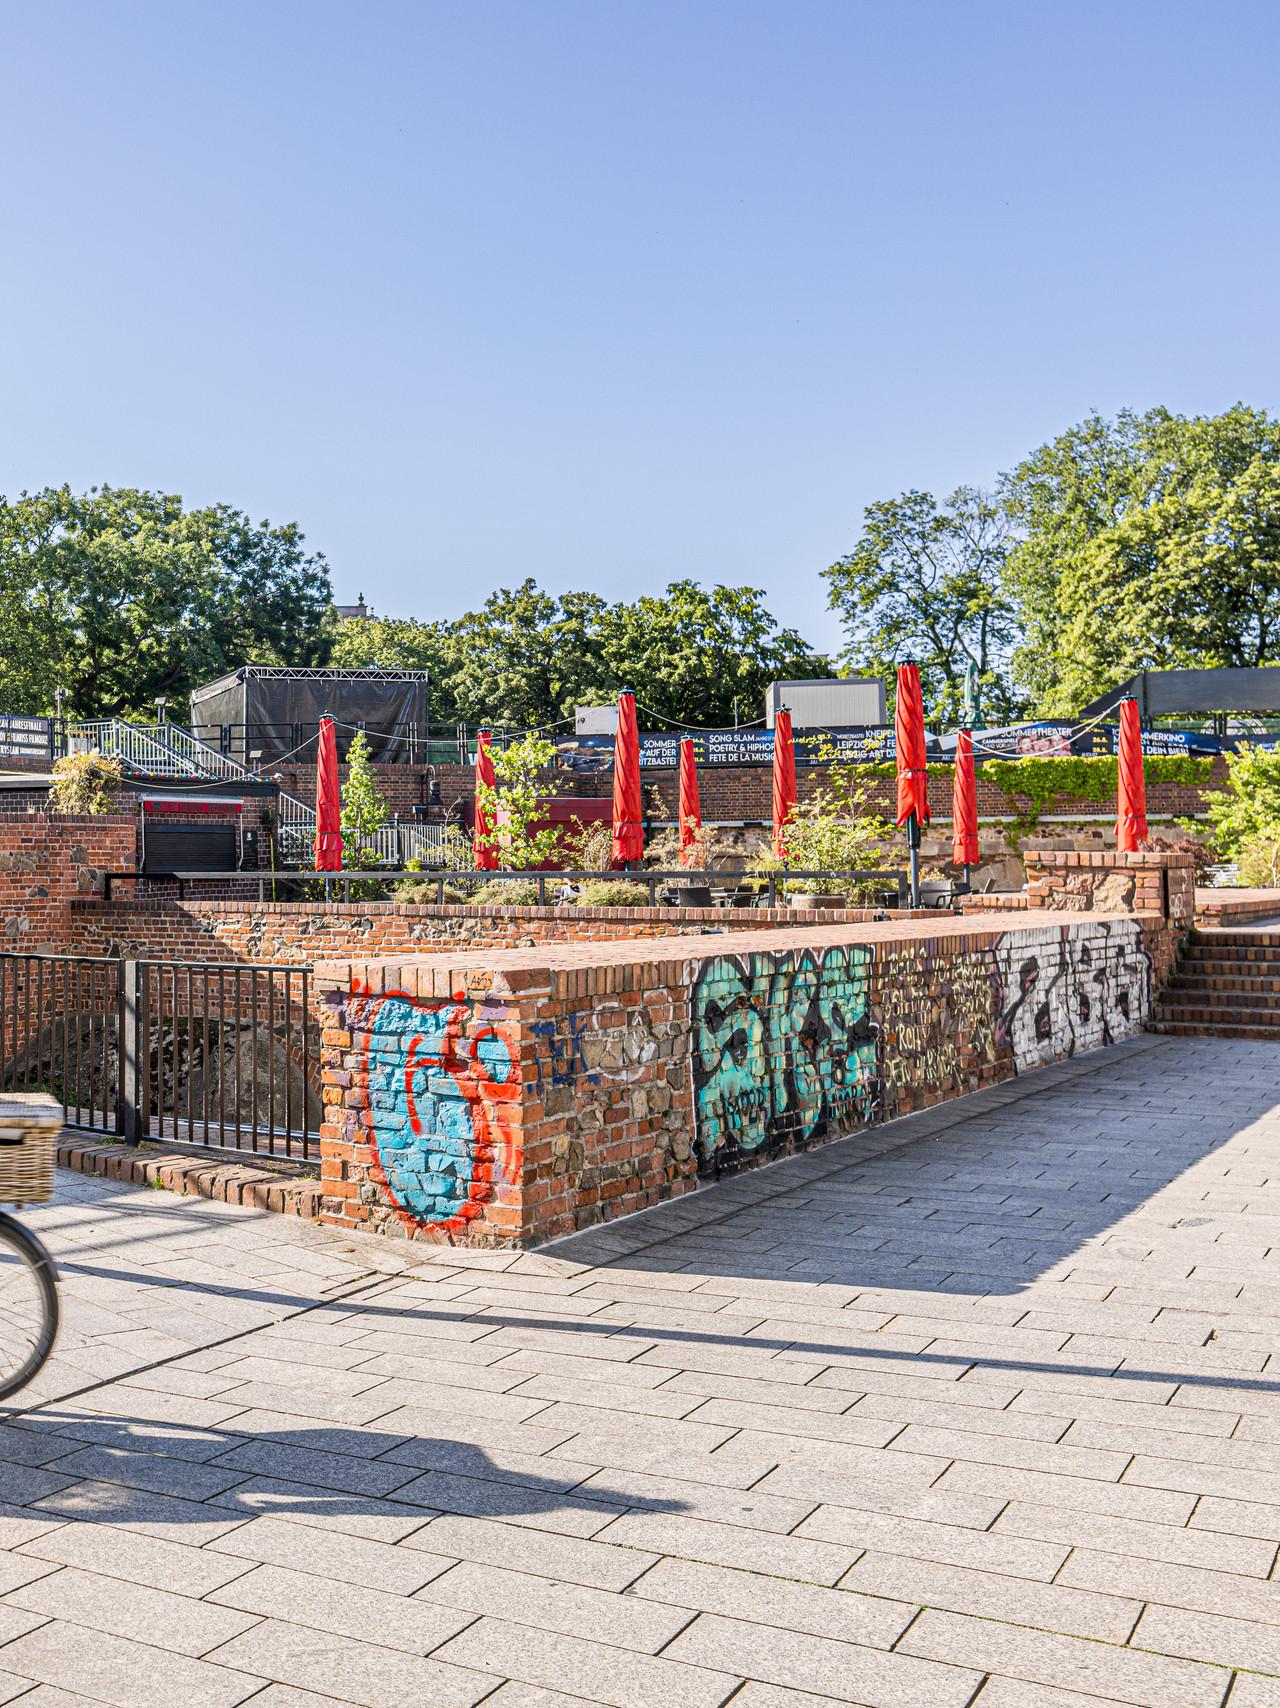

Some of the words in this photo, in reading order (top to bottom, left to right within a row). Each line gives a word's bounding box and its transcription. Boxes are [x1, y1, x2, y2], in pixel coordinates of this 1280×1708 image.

[1001, 727, 1072, 738] SOMMERTHEATER
[709, 735, 732, 743] SONG
[734, 734, 755, 743] SLAM
[644, 739, 676, 748] SOMMER
[709, 743, 738, 753] POETRY
[739, 743, 746, 752] &
[837, 740, 867, 748] LEIPZIG
[662, 748, 677, 757] DER
[1146, 745, 1166, 754] DEIN
[709, 754, 727, 762] FETE
[728, 753, 738, 762] DE
[740, 753, 750, 761] LA
